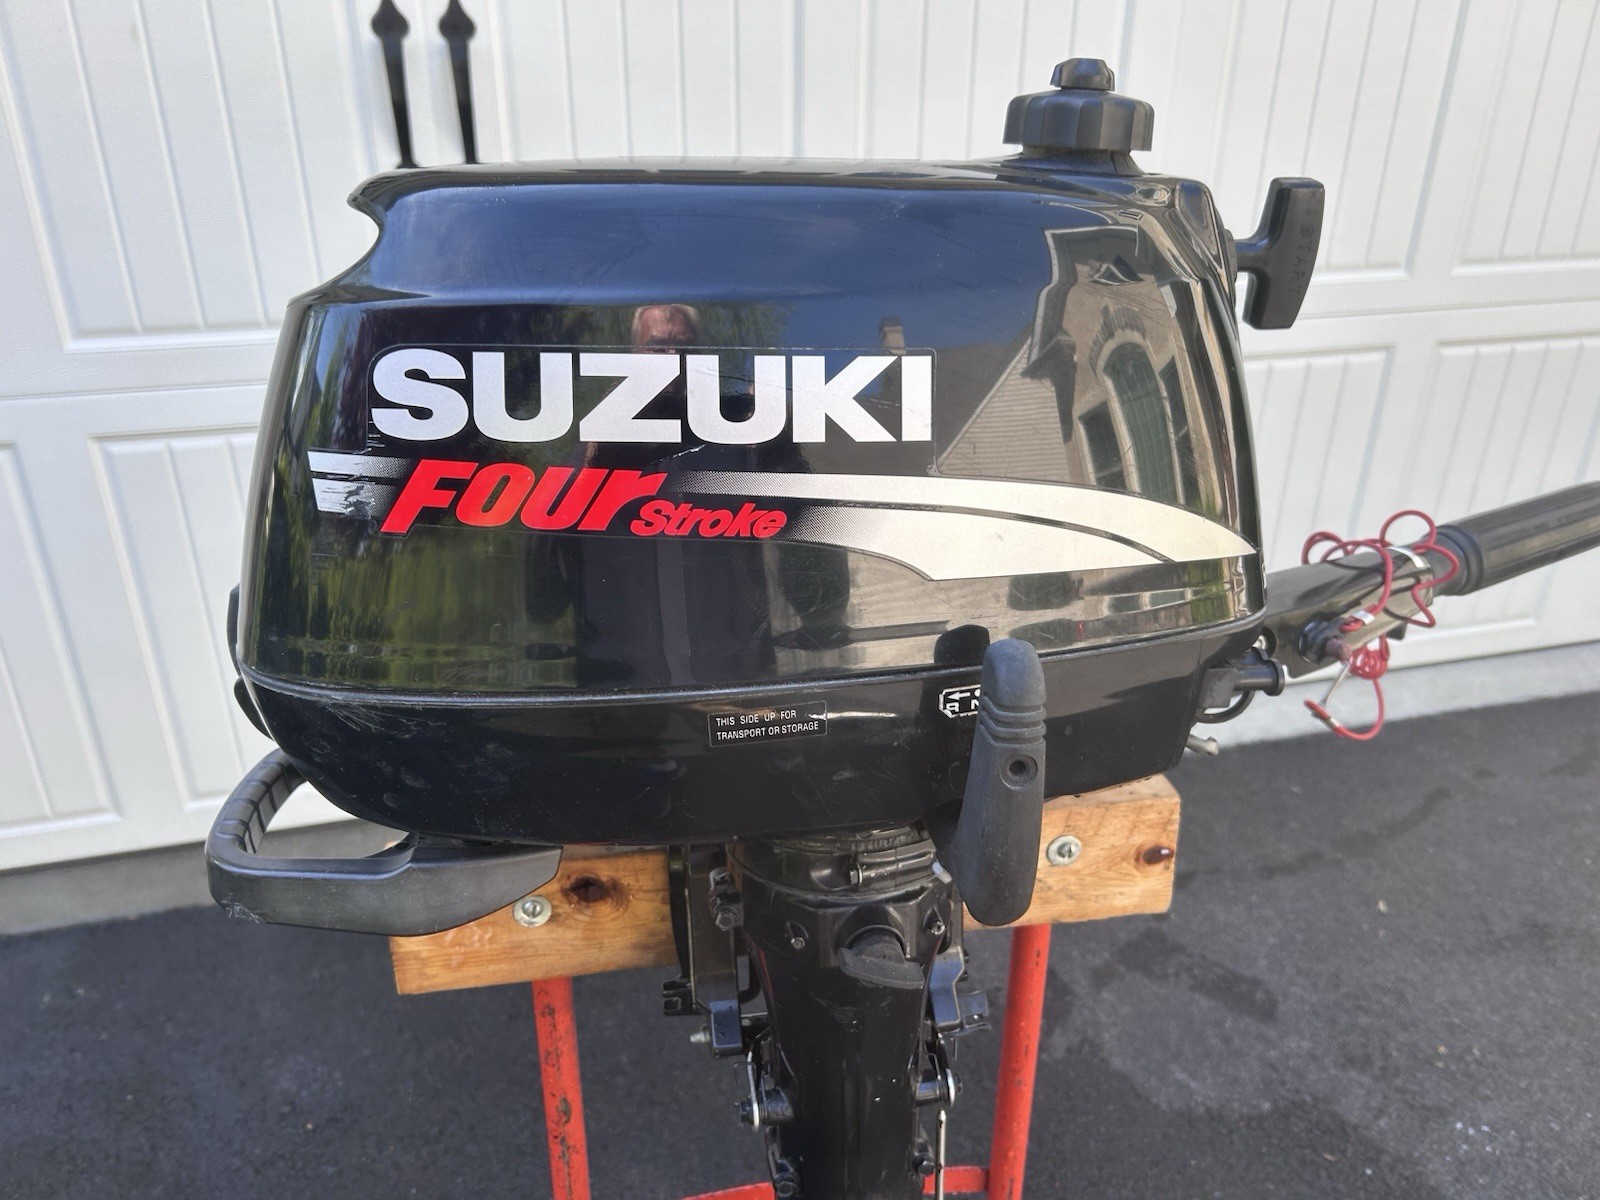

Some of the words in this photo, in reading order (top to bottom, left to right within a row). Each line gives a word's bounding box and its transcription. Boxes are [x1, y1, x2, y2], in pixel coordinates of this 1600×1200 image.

[1287, 223, 1316, 297] START
[371, 348, 933, 444] SUZUKI
[629, 499, 788, 538] Stroke
[716, 716, 736, 727] THIS
[740, 714, 759, 725] SIDE
[764, 712, 776, 722] UP
[780, 709, 797, 720] FOR
[716, 728, 767, 740] TRANSPORT
[767, 725, 780, 736] OR
[781, 721, 819, 734] STORAGE
